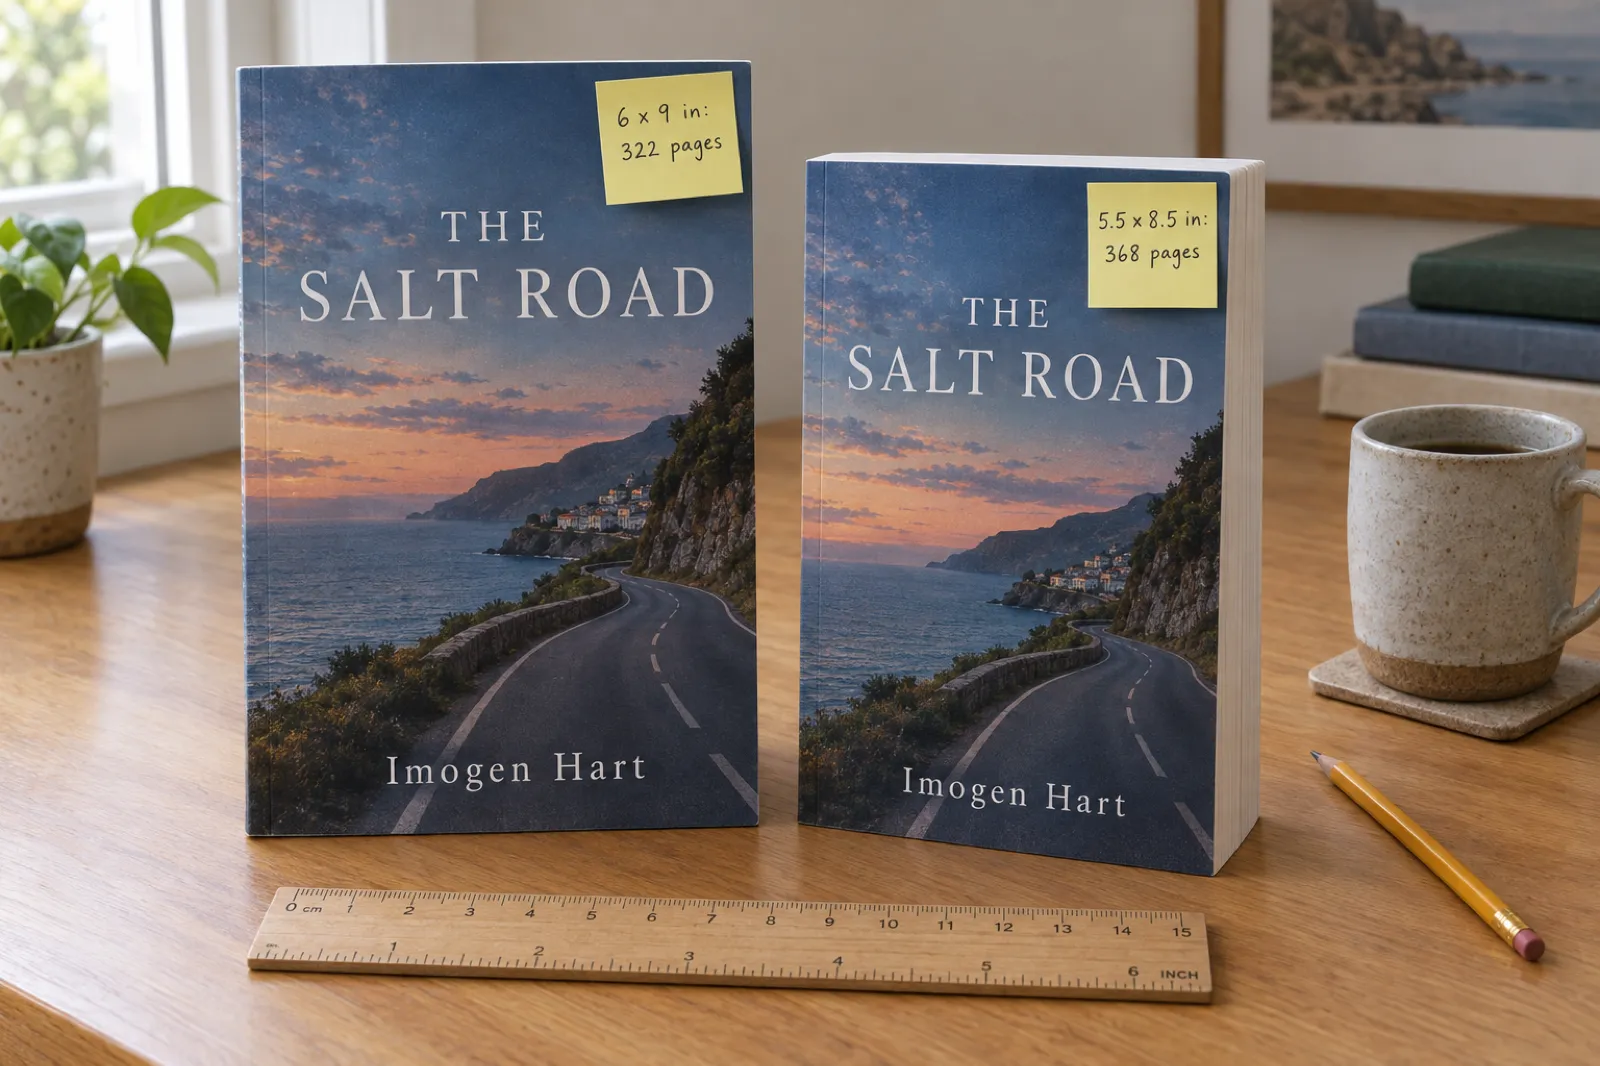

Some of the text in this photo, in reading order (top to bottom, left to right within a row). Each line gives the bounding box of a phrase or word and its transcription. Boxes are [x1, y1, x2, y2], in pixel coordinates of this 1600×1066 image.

[617, 103, 709, 128] 6 x 9 in:
[621, 136, 722, 163] 322 pages
[440, 210, 545, 242] THE
[1185, 210, 1208, 227] in:
[1105, 244, 1200, 270] 368 pages
[299, 266, 714, 323] SALT ROAD
[962, 297, 1049, 328] THE
[848, 344, 1193, 404] SALT ROAD
[387, 752, 645, 792] Imogen Hart
[903, 767, 1125, 817] Imogen Hart
[285, 902, 298, 912] 0
[346, 904, 353, 914] 1
[403, 906, 415, 915] 2
[464, 907, 475, 917] 3
[524, 909, 535, 918] 4
[586, 910, 597, 921] 5
[646, 912, 657, 922] 6
[706, 913, 717, 924] 7
[765, 915, 776, 926] 8
[824, 917, 835, 927] 9
[879, 919, 899, 930] 10
[938, 920, 953, 931] 11
[995, 922, 1013, 932] 12
[1053, 924, 1072, 934] 13
[1113, 925, 1132, 936] 14
[1172, 927, 1192, 938] 15
[390, 941, 1199, 981] 1 2 3 4 5 6 INCH
